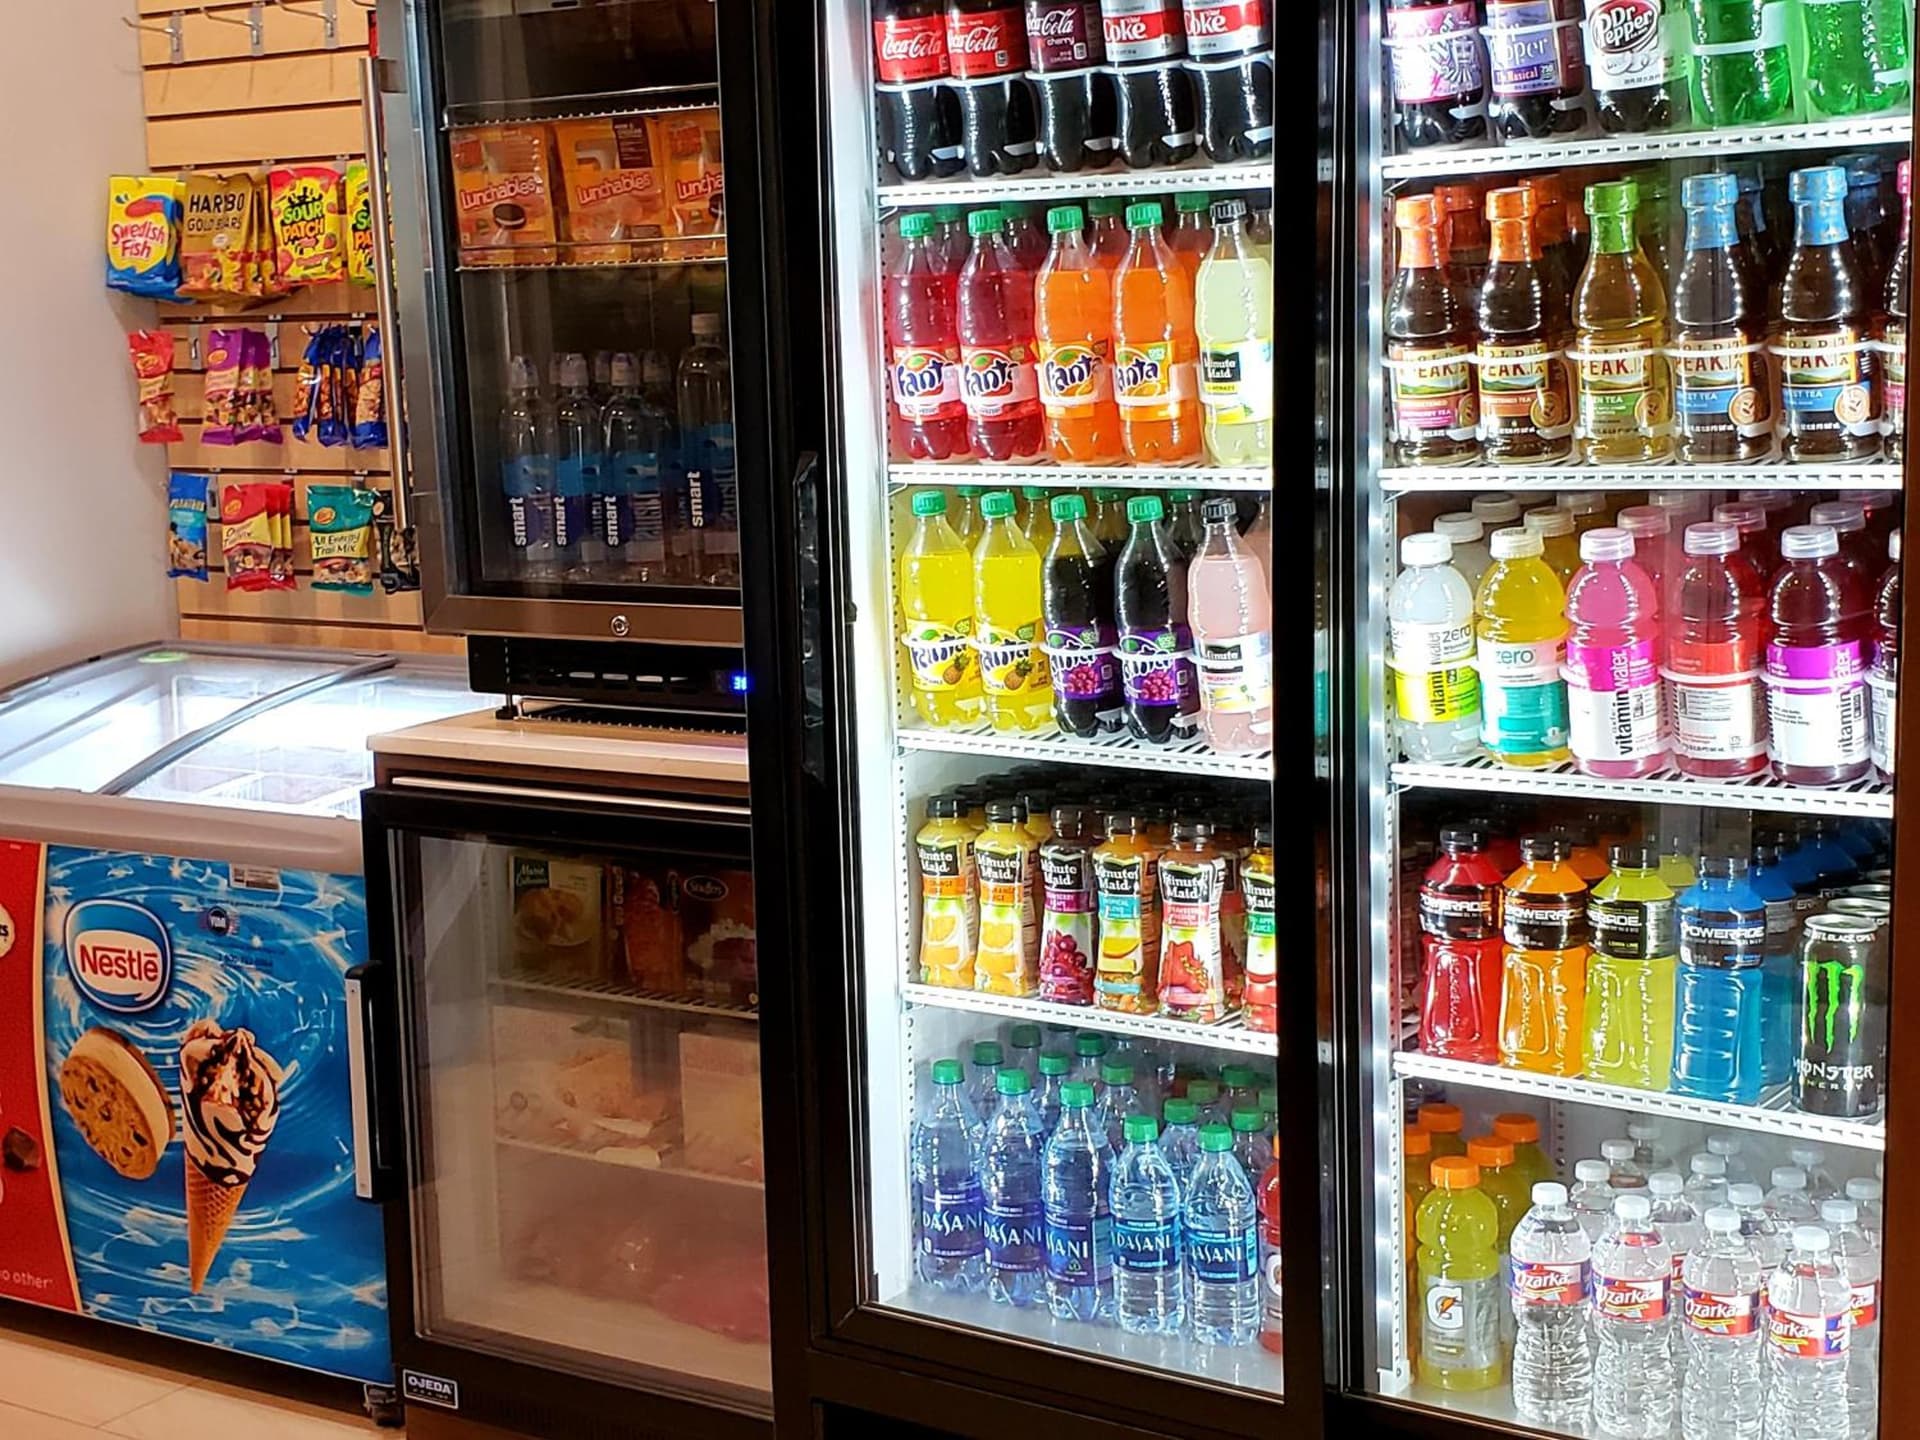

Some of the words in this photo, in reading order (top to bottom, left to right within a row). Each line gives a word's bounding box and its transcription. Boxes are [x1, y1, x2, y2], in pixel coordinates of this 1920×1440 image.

[1611, 5, 1637, 28] Dr
[1596, 9, 1653, 49] Pepper
[1047, 37, 1075, 46] cherry
[461, 174, 536, 210] Lunchables
[576, 171, 652, 207] Lunchables
[676, 171, 723, 200] Luncha
[188, 191, 246, 214] HARIBO
[283, 201, 325, 223] SOUR
[111, 219, 166, 245] Swedish
[281, 220, 325, 243] PATCH
[120, 239, 153, 259] Fish
[1789, 340, 1828, 350] OLD
[896, 359, 953, 397] Fant
[1116, 358, 1158, 392] anta
[1516, 396, 1532, 404] TEA
[1604, 396, 1624, 404] TEA
[1699, 393, 1718, 401] TEA
[1805, 391, 1823, 399] TEA
[687, 470, 704, 528] smart
[509, 496, 527, 547] smart
[553, 495, 567, 547] smart
[604, 495, 620, 547] smart
[336, 543, 357, 554] Mix
[1442, 624, 1472, 643] zero
[1496, 649, 1534, 664] zero
[918, 848, 953, 862] Minute
[977, 853, 1018, 869] Minute
[920, 860, 950, 873] Maid
[981, 867, 1014, 880] Maid
[1041, 858, 1078, 875] Minute
[1044, 872, 1074, 886] Maid
[1098, 877, 1132, 891] Maid
[1163, 872, 1205, 888] Minute
[1166, 886, 1199, 900] Maid
[1681, 920, 1765, 939] POWERADE
[1793, 1056, 1874, 1079] MONSTER
[922, 1210, 983, 1236] DASANI
[983, 1220, 1042, 1248] DASANI
[1116, 1233, 1170, 1252] DASANI
[1046, 1230, 1089, 1259] SANI
[1191, 1244, 1242, 1264] ASANI
[12, 1271, 50, 1289] other
[1514, 1271, 1570, 1289] Ozarka
[1600, 1286, 1651, 1304] Ozarka
[1426, 1286, 1464, 1329] G
[1685, 1299, 1738, 1317] Ozarka
[1768, 1318, 1810, 1337] zarka
[407, 1375, 452, 1395] OJEDA
